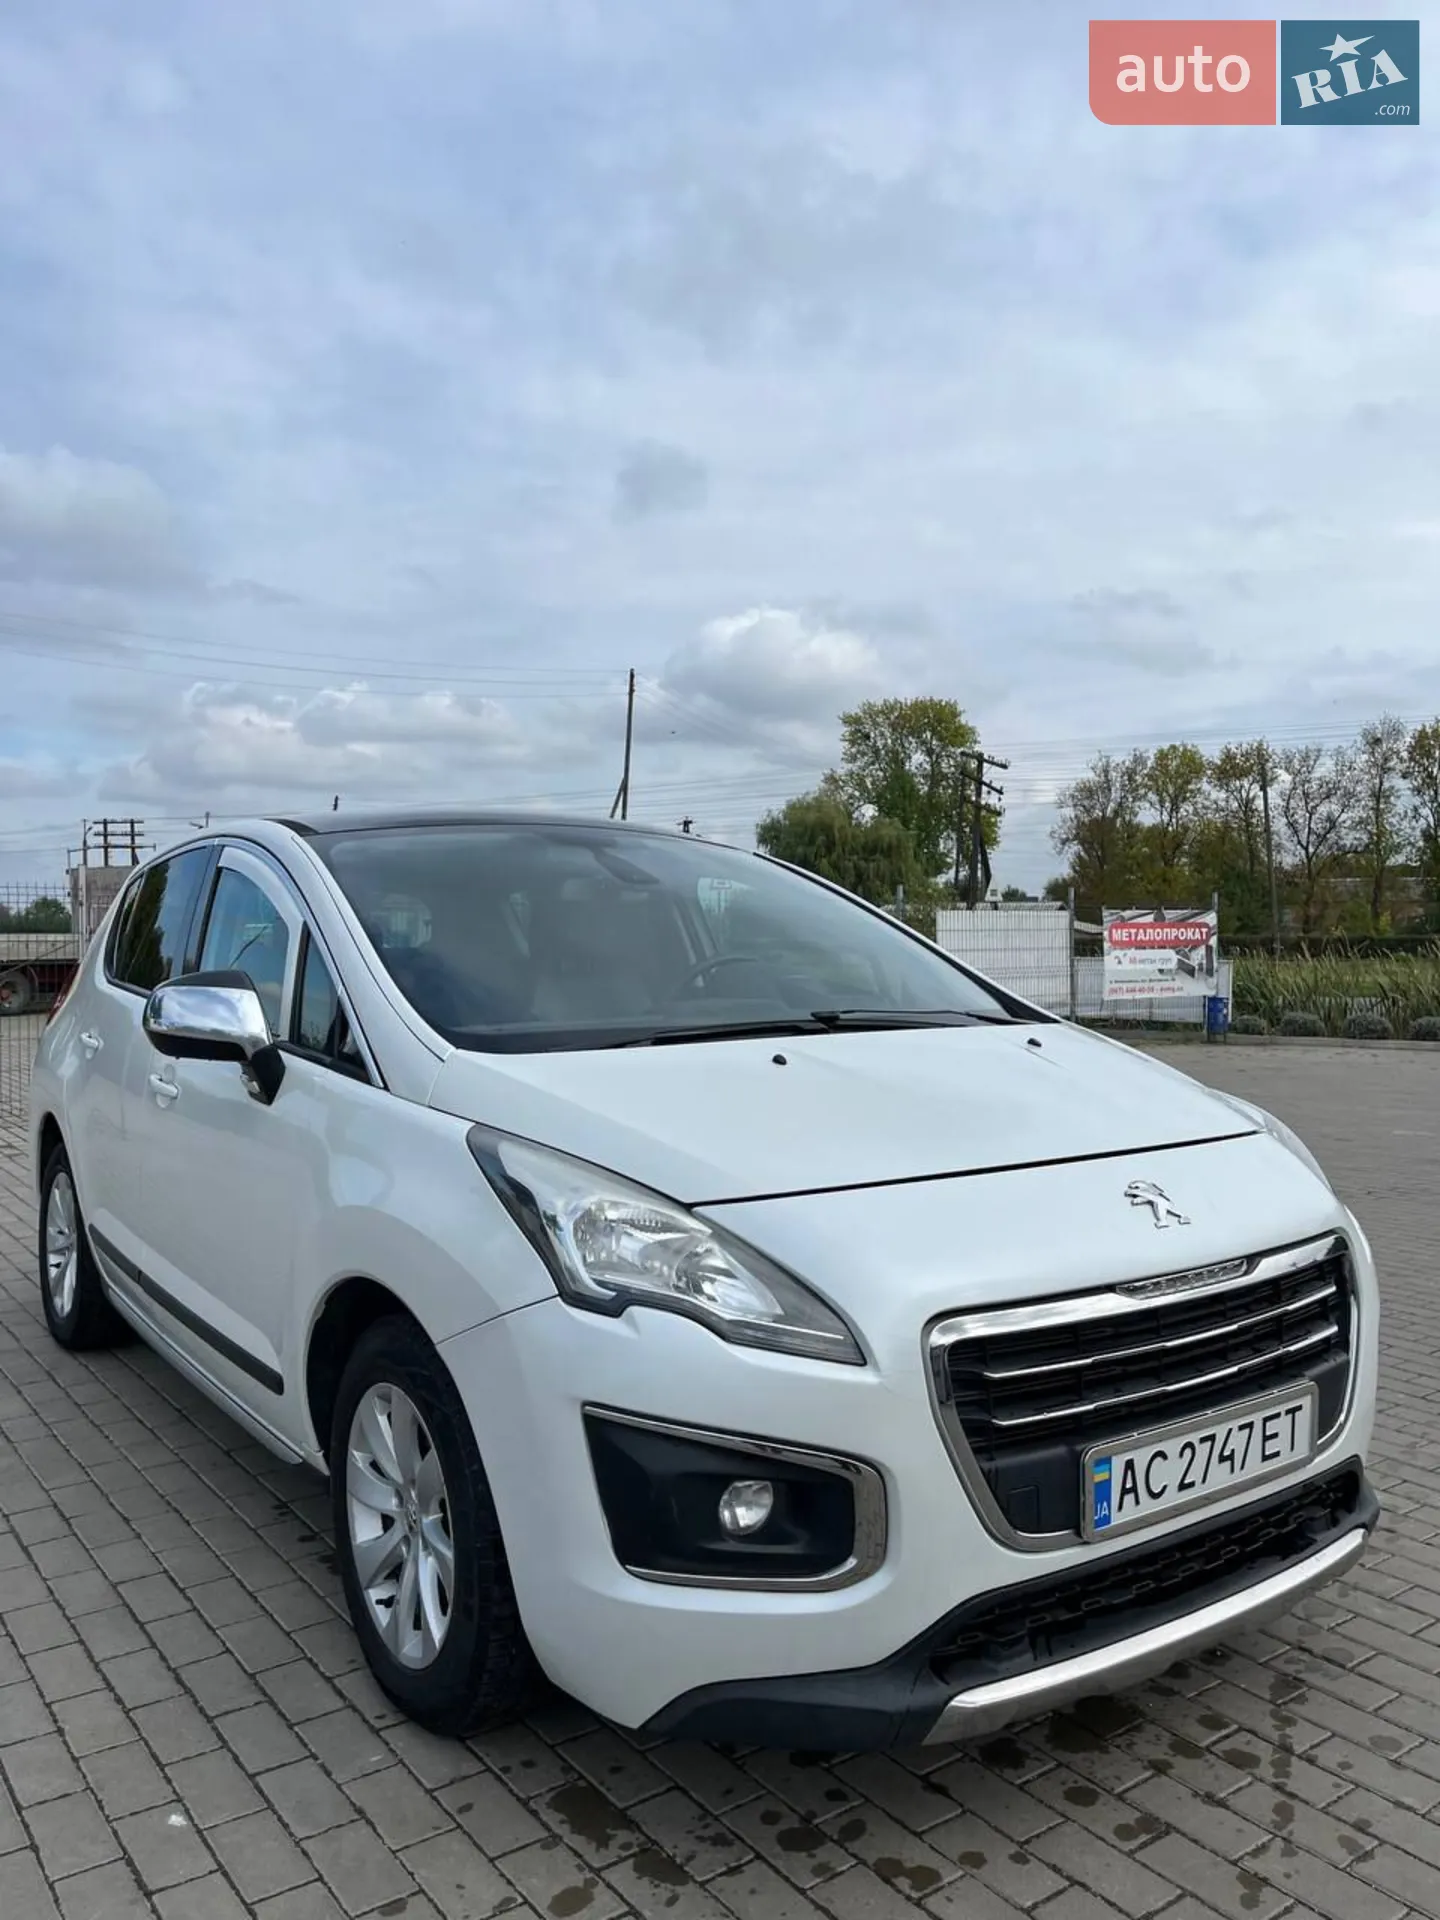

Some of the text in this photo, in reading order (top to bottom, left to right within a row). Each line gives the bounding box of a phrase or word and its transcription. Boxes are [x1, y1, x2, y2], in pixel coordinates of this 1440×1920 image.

[1112, 928, 1209, 941] МЕТАЛОПРОКАТ
[1117, 1404, 1303, 1512] AC 2747 ET
